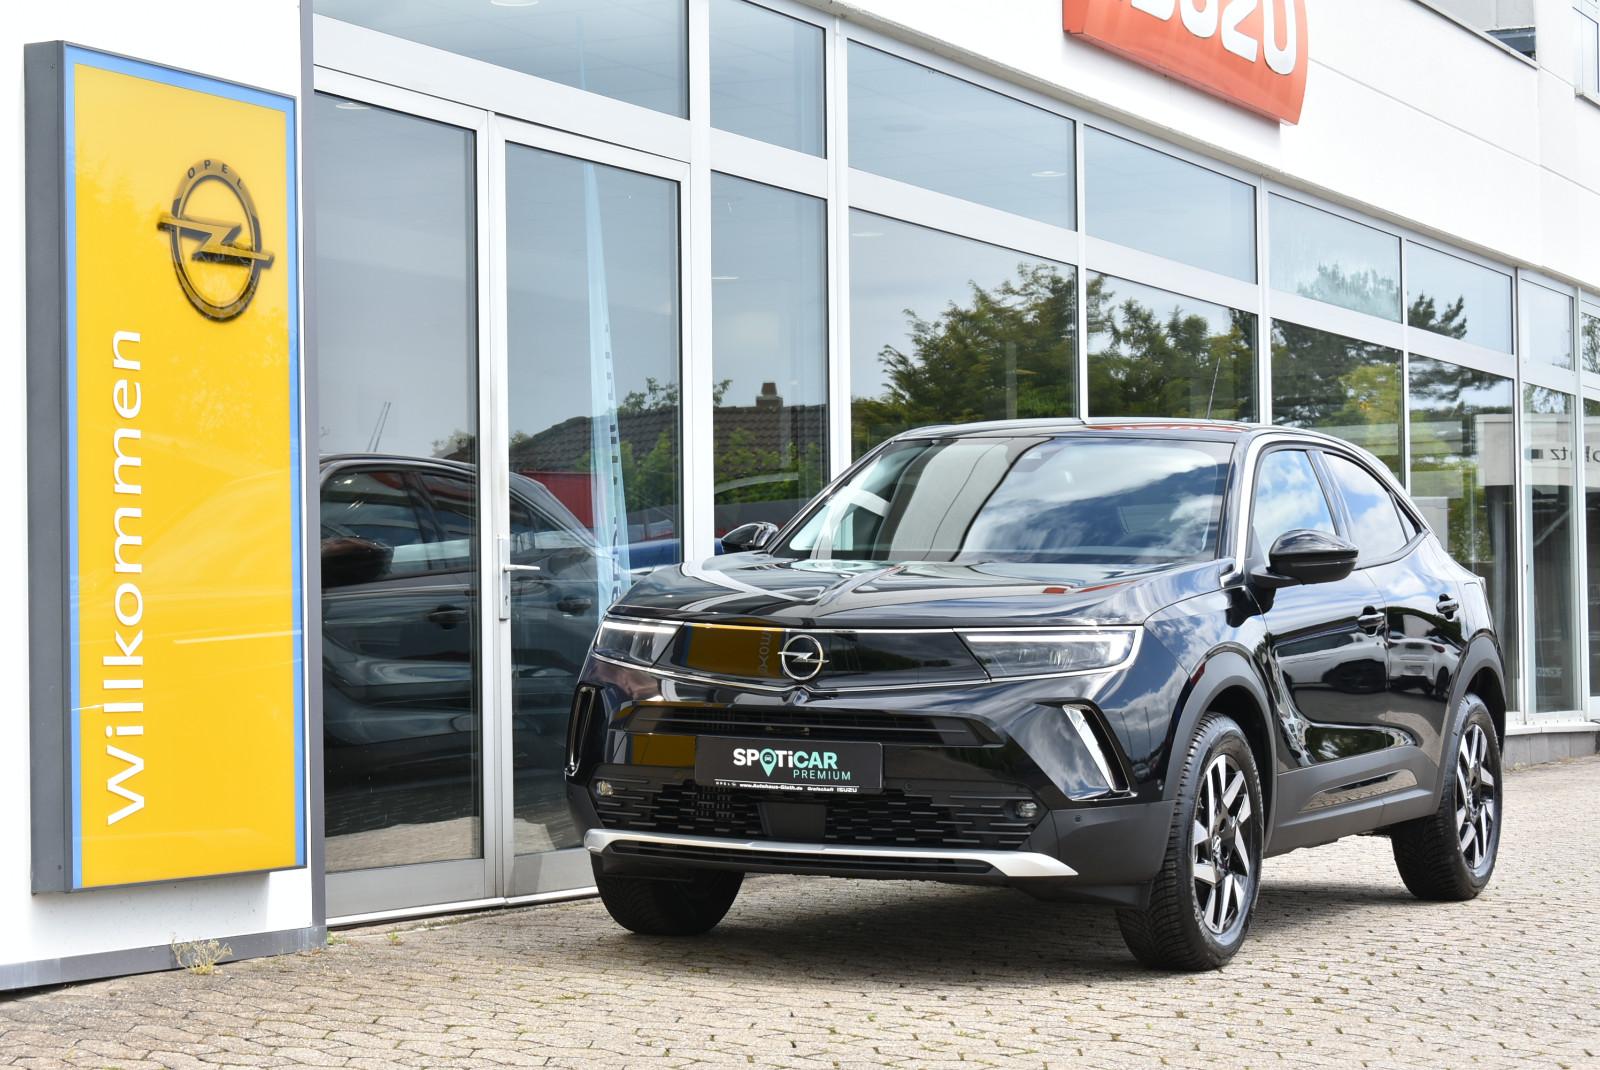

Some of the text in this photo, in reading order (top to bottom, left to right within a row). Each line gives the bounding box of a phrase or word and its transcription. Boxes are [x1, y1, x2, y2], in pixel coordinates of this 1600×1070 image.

[187, 159, 244, 190] OPEL
[102, 329, 145, 826] Willkommen
[793, 769, 851, 781] PREMIUM
